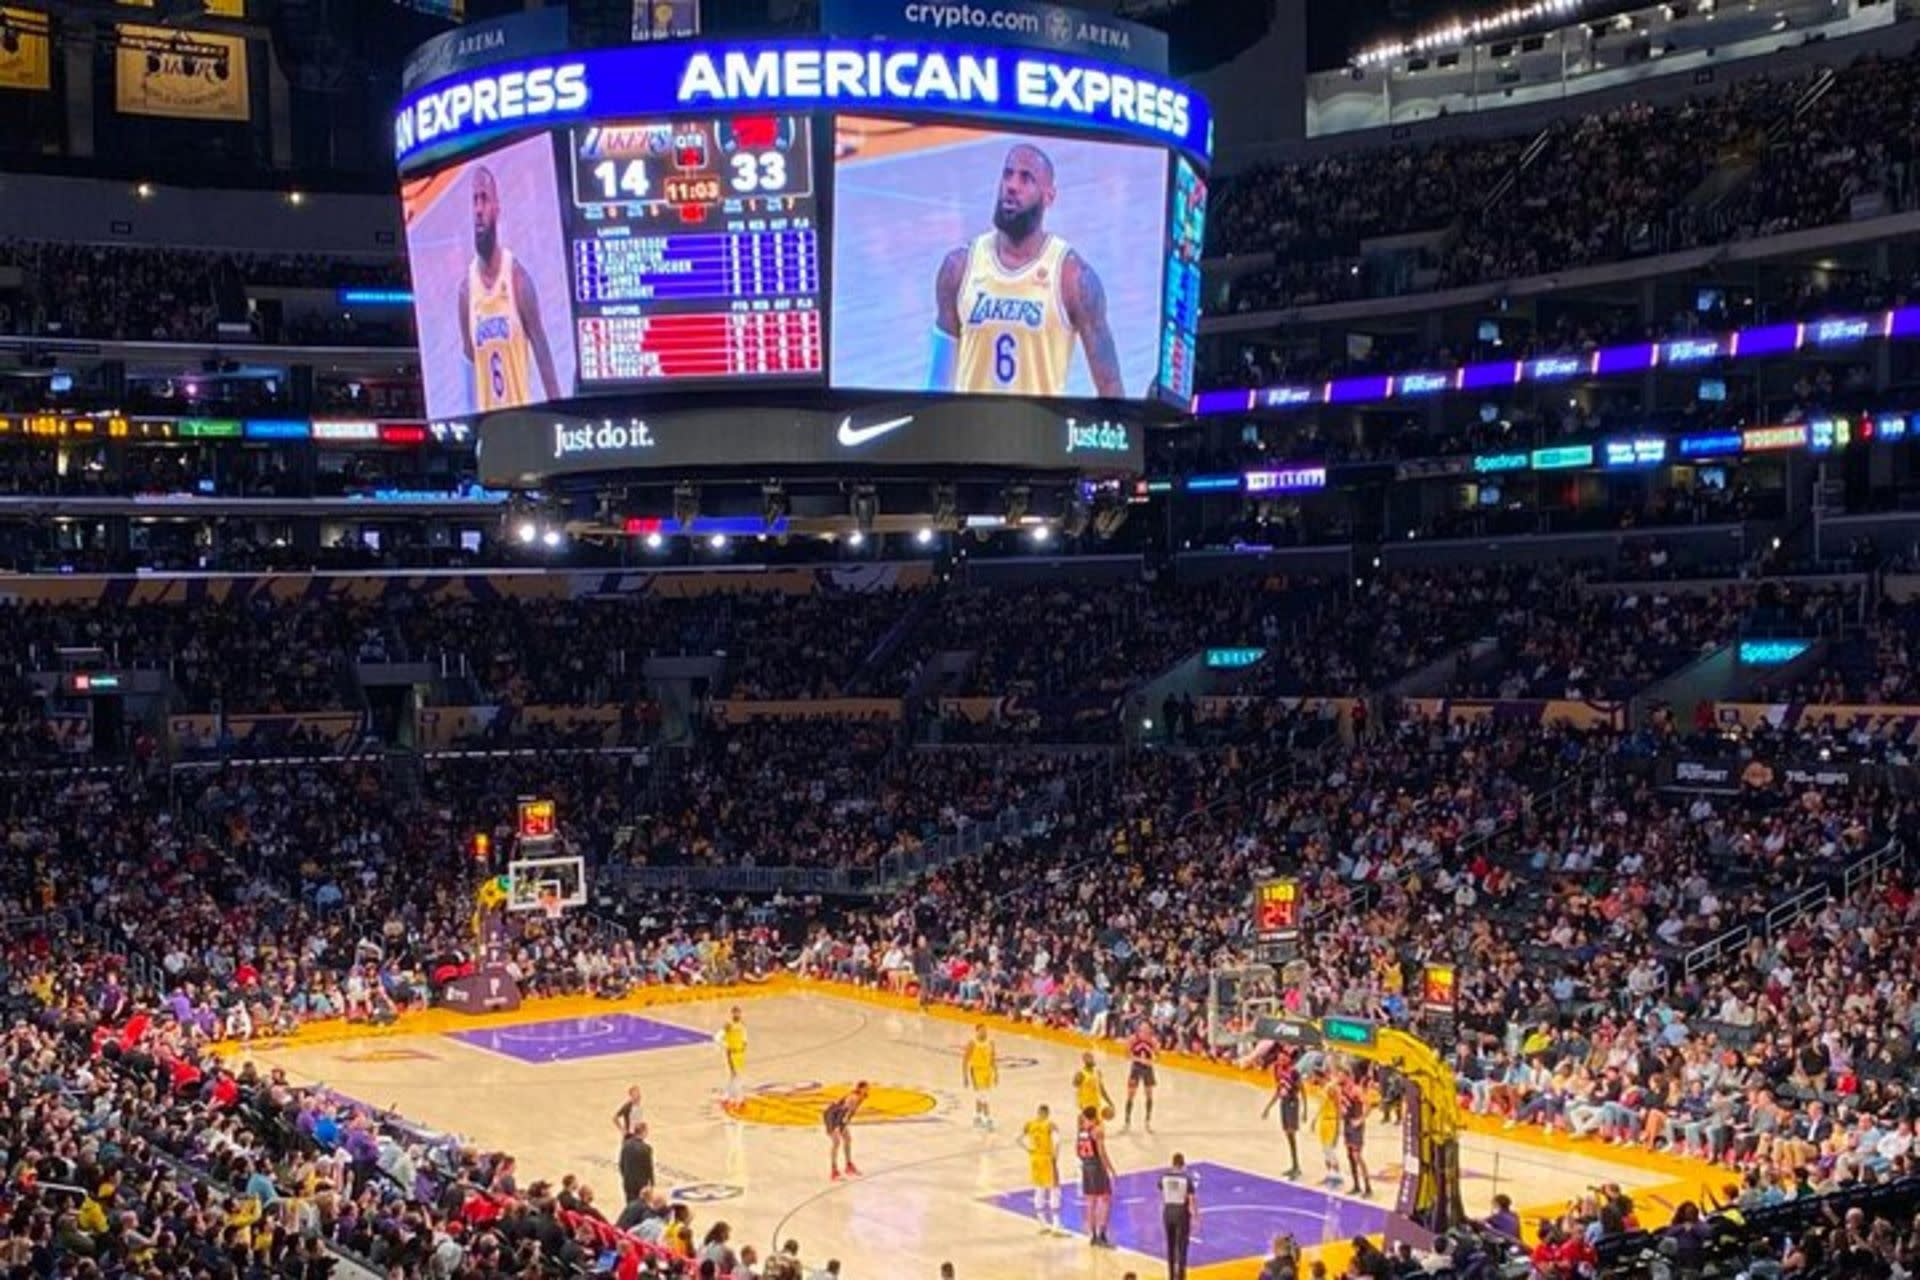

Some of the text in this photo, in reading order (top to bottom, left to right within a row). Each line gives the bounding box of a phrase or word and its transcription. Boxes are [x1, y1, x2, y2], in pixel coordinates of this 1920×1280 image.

[905, 3, 1131, 49] crypto.com ARENA
[417, 63, 589, 142] EXPRESS
[677, 50, 1190, 138] AMERICAN EXPRESS
[594, 159, 649, 197] 14
[667, 182, 720, 199] 11:03
[730, 151, 787, 192] 33
[968, 292, 1044, 327] LAKERS
[995, 332, 1017, 383] 6
[554, 418, 654, 458] Just do it.
[1066, 418, 1099, 452] Just
[1474, 454, 1527, 473] Spectrum
